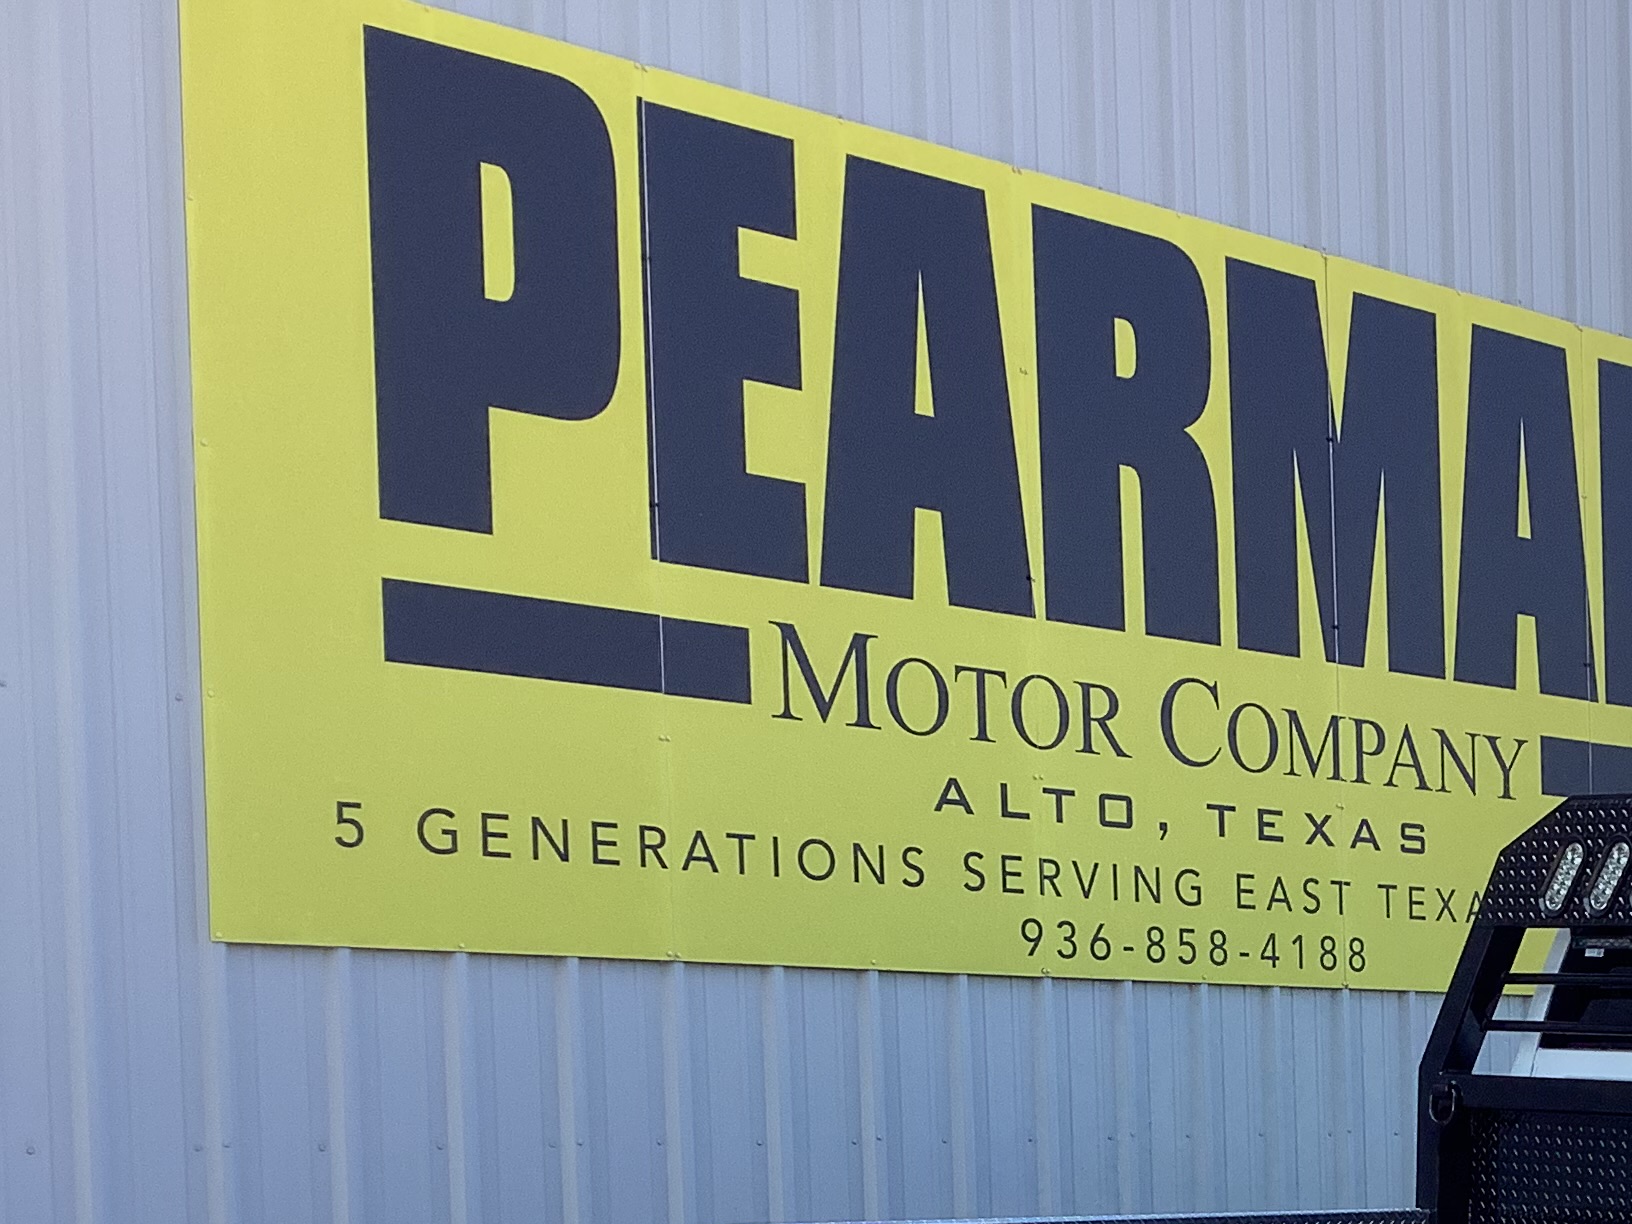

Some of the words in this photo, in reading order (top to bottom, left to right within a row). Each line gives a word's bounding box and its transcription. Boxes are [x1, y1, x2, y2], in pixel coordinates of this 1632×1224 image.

[768, 620, 1133, 759] MOTOR
[1160, 677, 1529, 801] COMPANY
[334, 800, 364, 849] 5
[417, 807, 926, 889] GENERATIONS
[963, 851, 1204, 907] SERVING
[1236, 872, 1351, 916] EAST
[1377, 883, 1484, 924] TEXA
[933, 777, 1168, 841] ALTO,
[1206, 803, 1426, 855] TEXAS
[1020, 917, 1367, 973] 936-858-4188
